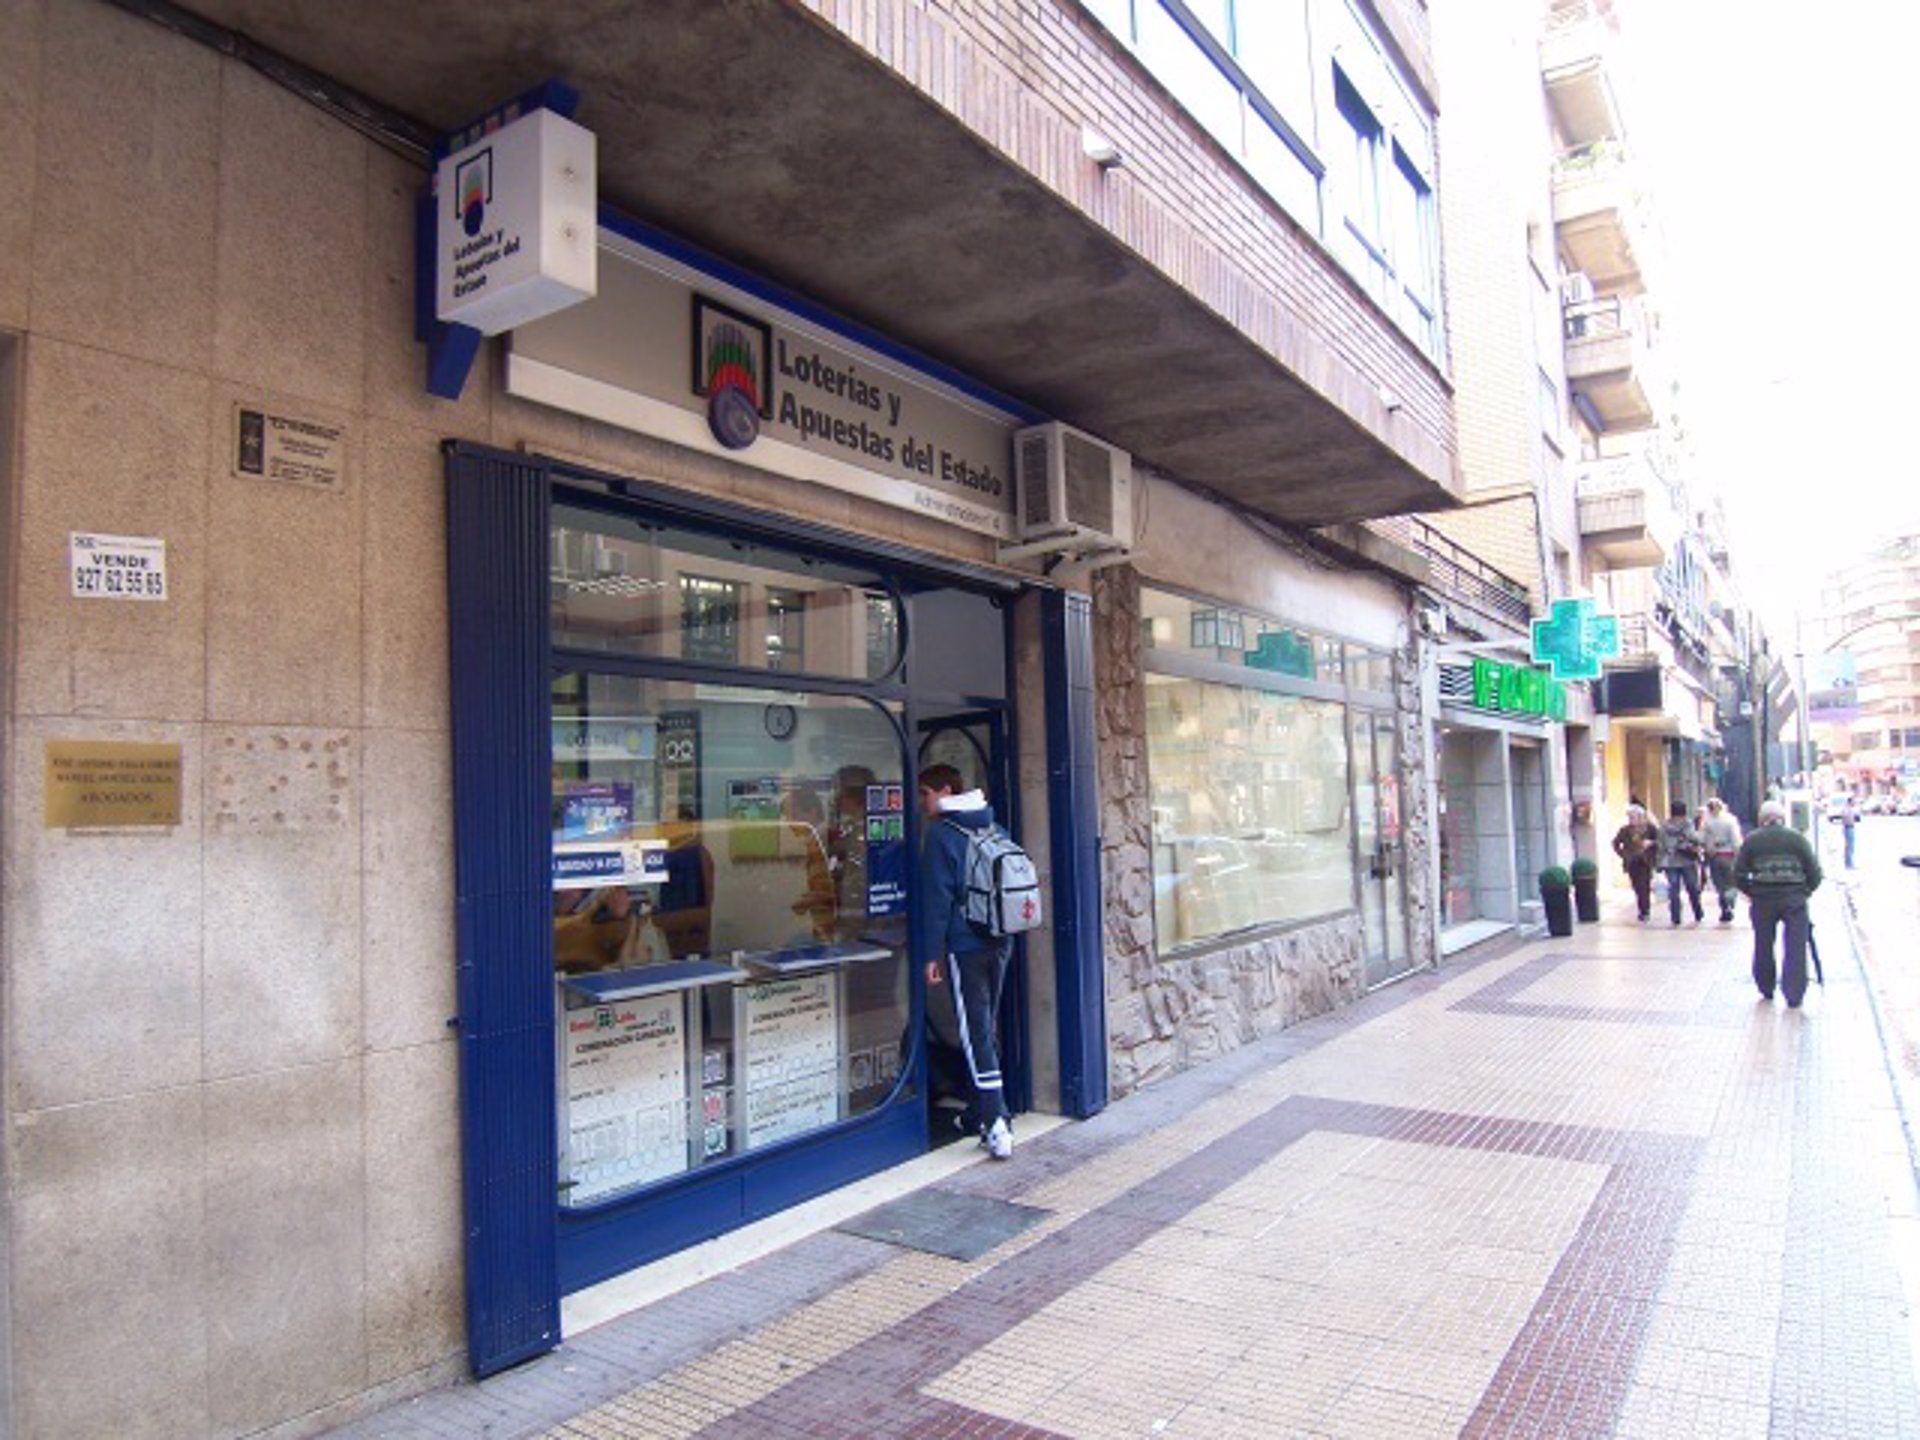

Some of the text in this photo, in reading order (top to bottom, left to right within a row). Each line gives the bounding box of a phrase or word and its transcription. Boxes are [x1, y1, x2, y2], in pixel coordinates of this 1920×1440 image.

[887, 392, 901, 425] y
[780, 391, 1002, 495] Apuestas del Estado
[92, 553, 149, 568] VENDE
[76, 566, 101, 591] 927
[126, 570, 143, 595] 55
